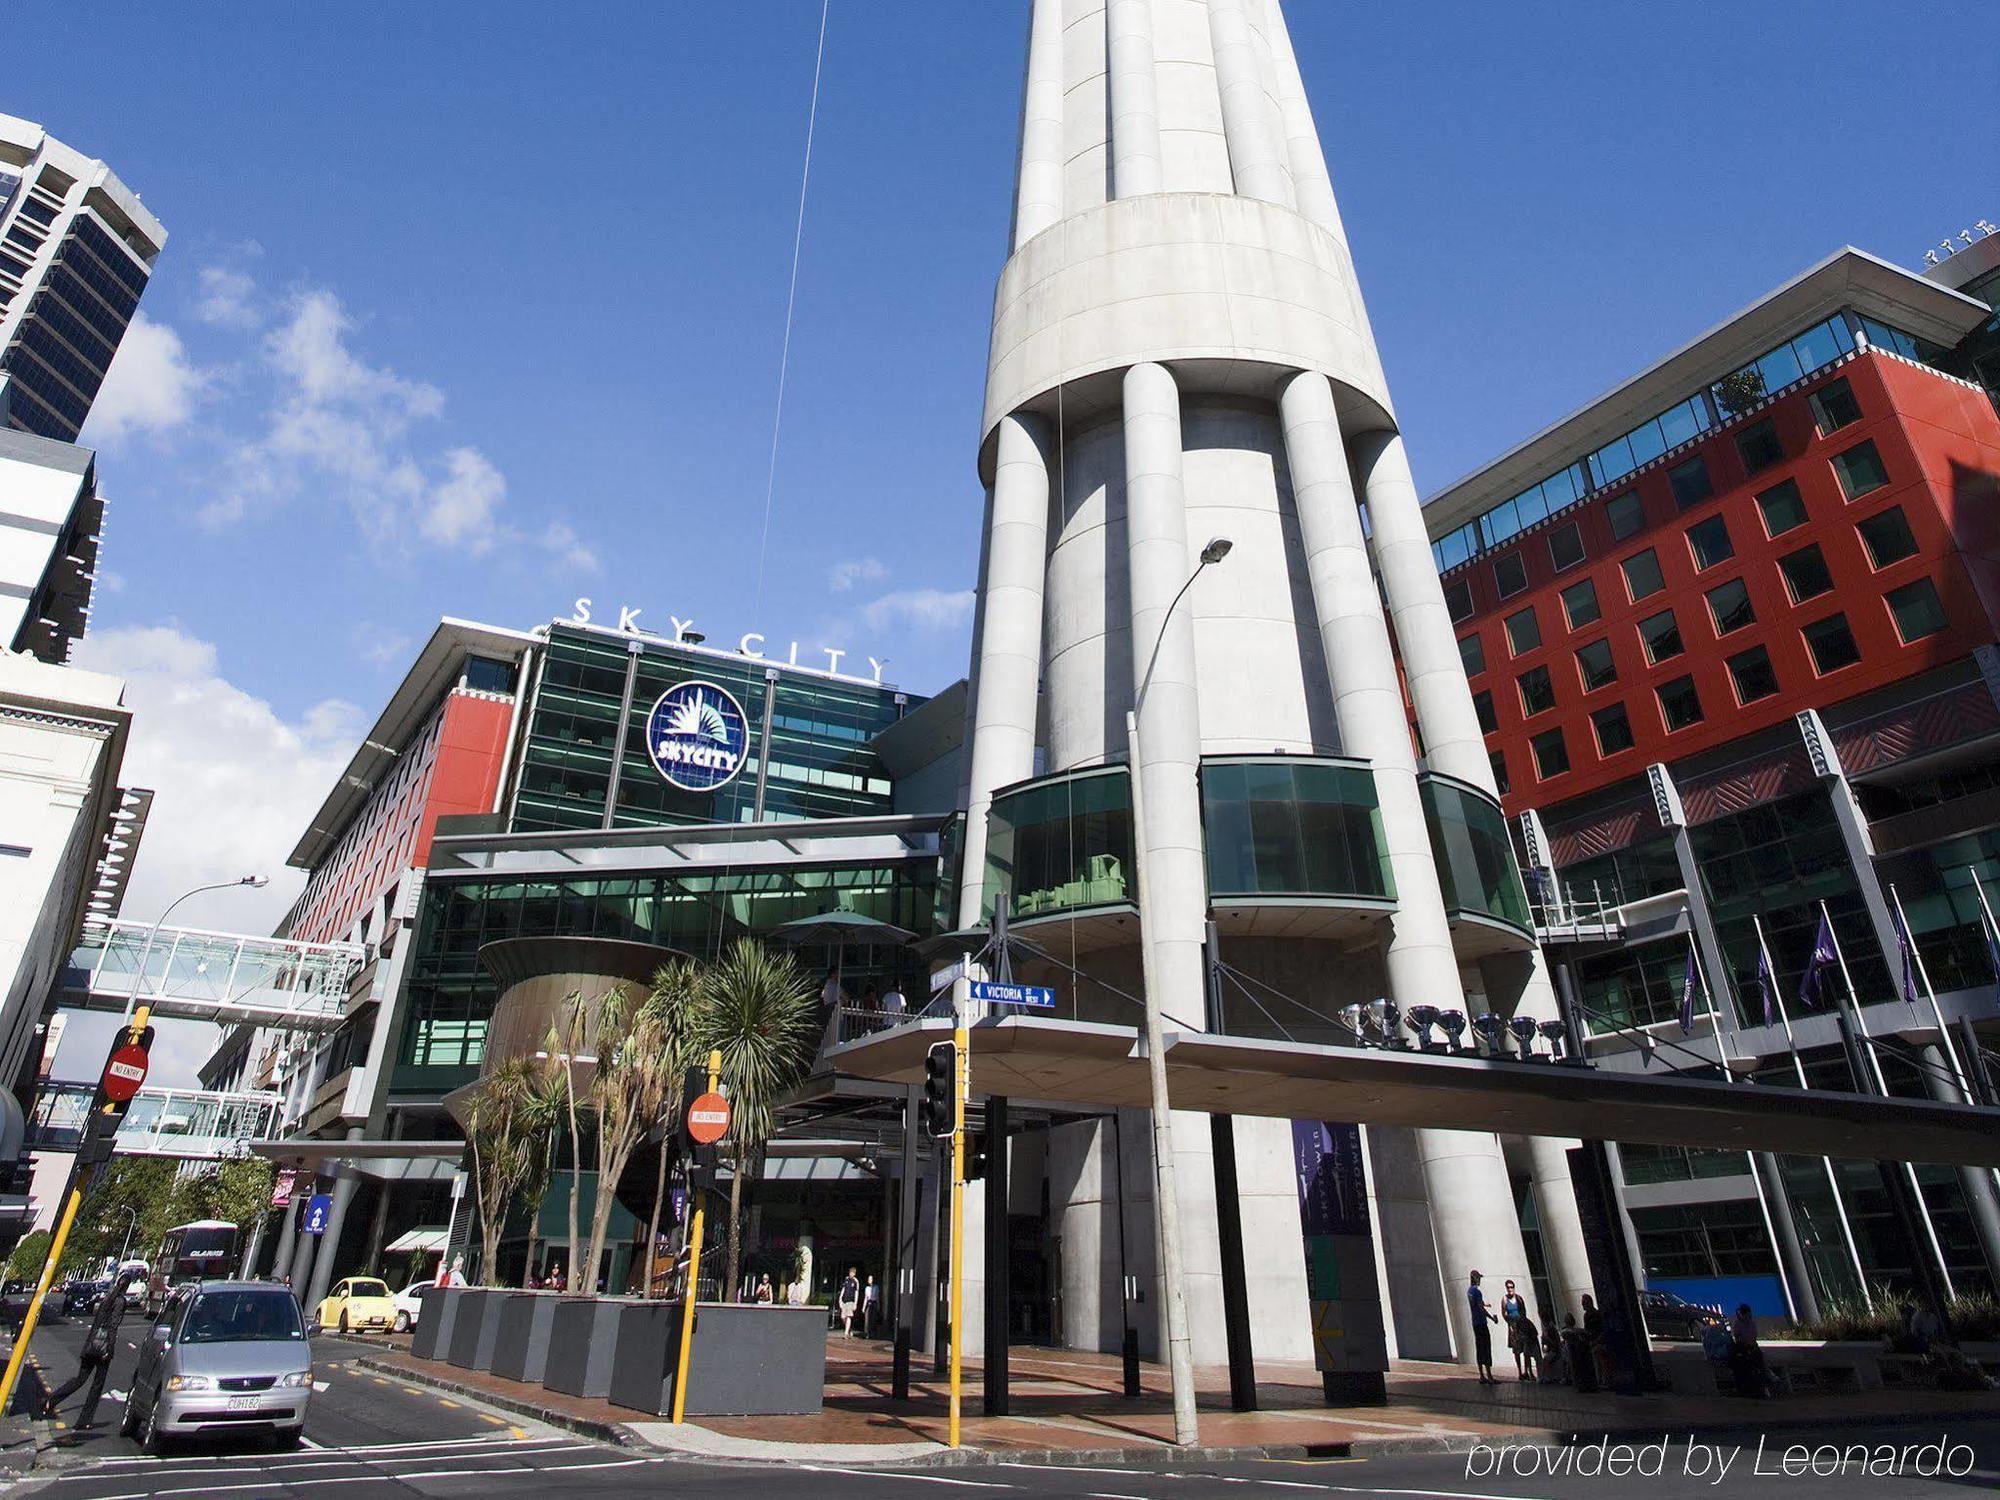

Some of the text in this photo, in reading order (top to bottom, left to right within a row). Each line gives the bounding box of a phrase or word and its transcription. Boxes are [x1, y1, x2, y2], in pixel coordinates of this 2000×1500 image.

[573, 597, 888, 682] SKY CITY
[658, 740, 738, 771] SKYCITY
[986, 986, 1022, 1000] VICTORIA
[122, 1065, 141, 1078] ENTRY
